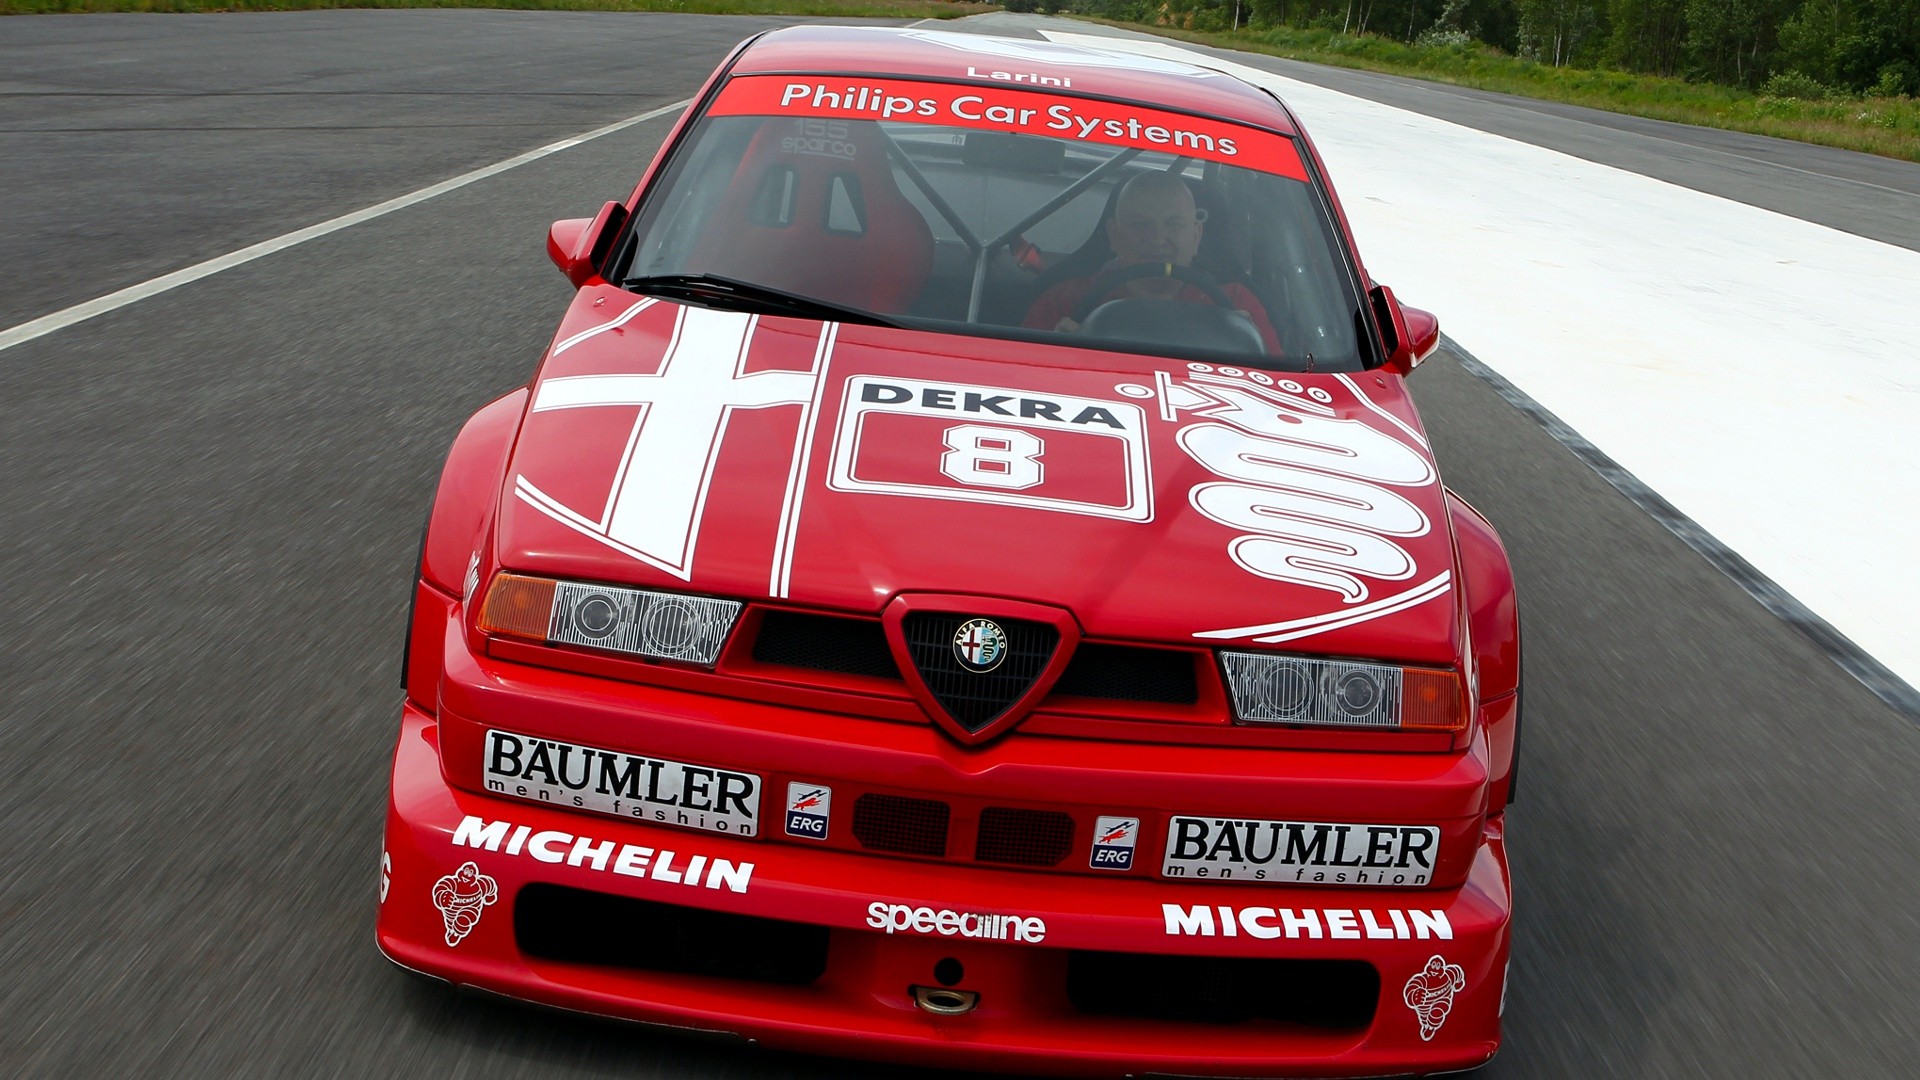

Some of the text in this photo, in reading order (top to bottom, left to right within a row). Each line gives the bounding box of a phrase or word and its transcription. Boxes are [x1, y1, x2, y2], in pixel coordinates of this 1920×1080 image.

[966, 66, 1071, 87] Larini
[780, 83, 1238, 155] Philips Car Systems
[781, 136, 856, 157] sparco
[860, 383, 1127, 430] DEKRA
[940, 424, 1044, 489] 8
[955, 620, 1006, 649] ALFA ROMEO
[487, 731, 756, 820] BÄUMLER
[488, 778, 752, 836] men's fashion
[789, 815, 824, 835] ERG
[451, 815, 755, 894] MICHELIN
[1094, 849, 1129, 865] ERG
[1170, 817, 1434, 869] BÄUMLER
[1166, 864, 1427, 886] men's fashion
[1162, 904, 1454, 940] MICHELIN
